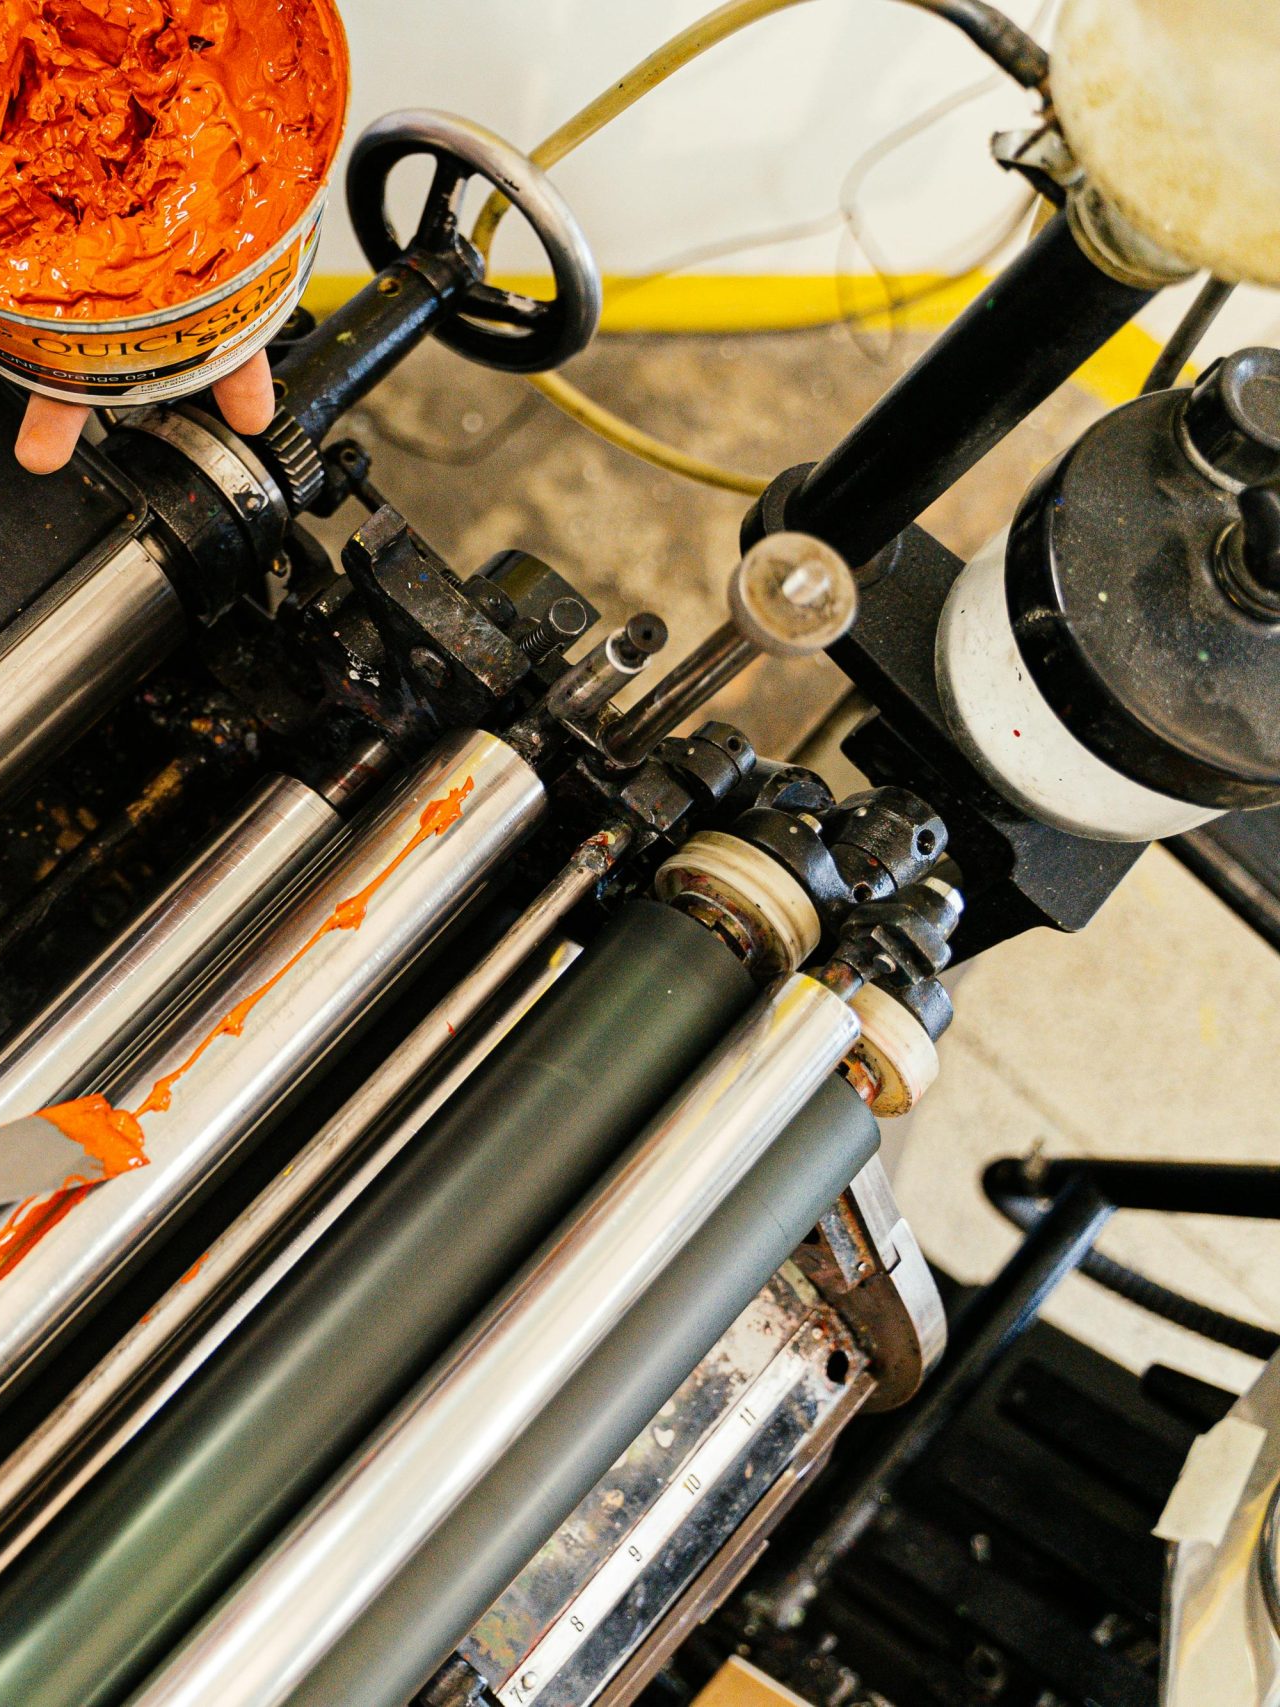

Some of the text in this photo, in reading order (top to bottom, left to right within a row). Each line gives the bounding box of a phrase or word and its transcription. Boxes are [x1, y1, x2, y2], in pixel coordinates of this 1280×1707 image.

[32, 253, 292, 358] QUICKSON
[52, 369, 120, 383] Orange
[125, 371, 156, 382] 021
[570, 1614, 585, 1632] 8
[628, 1544, 642, 1562] 9
[682, 1472, 702, 1496] 10
[739, 1406, 757, 1427] 11
